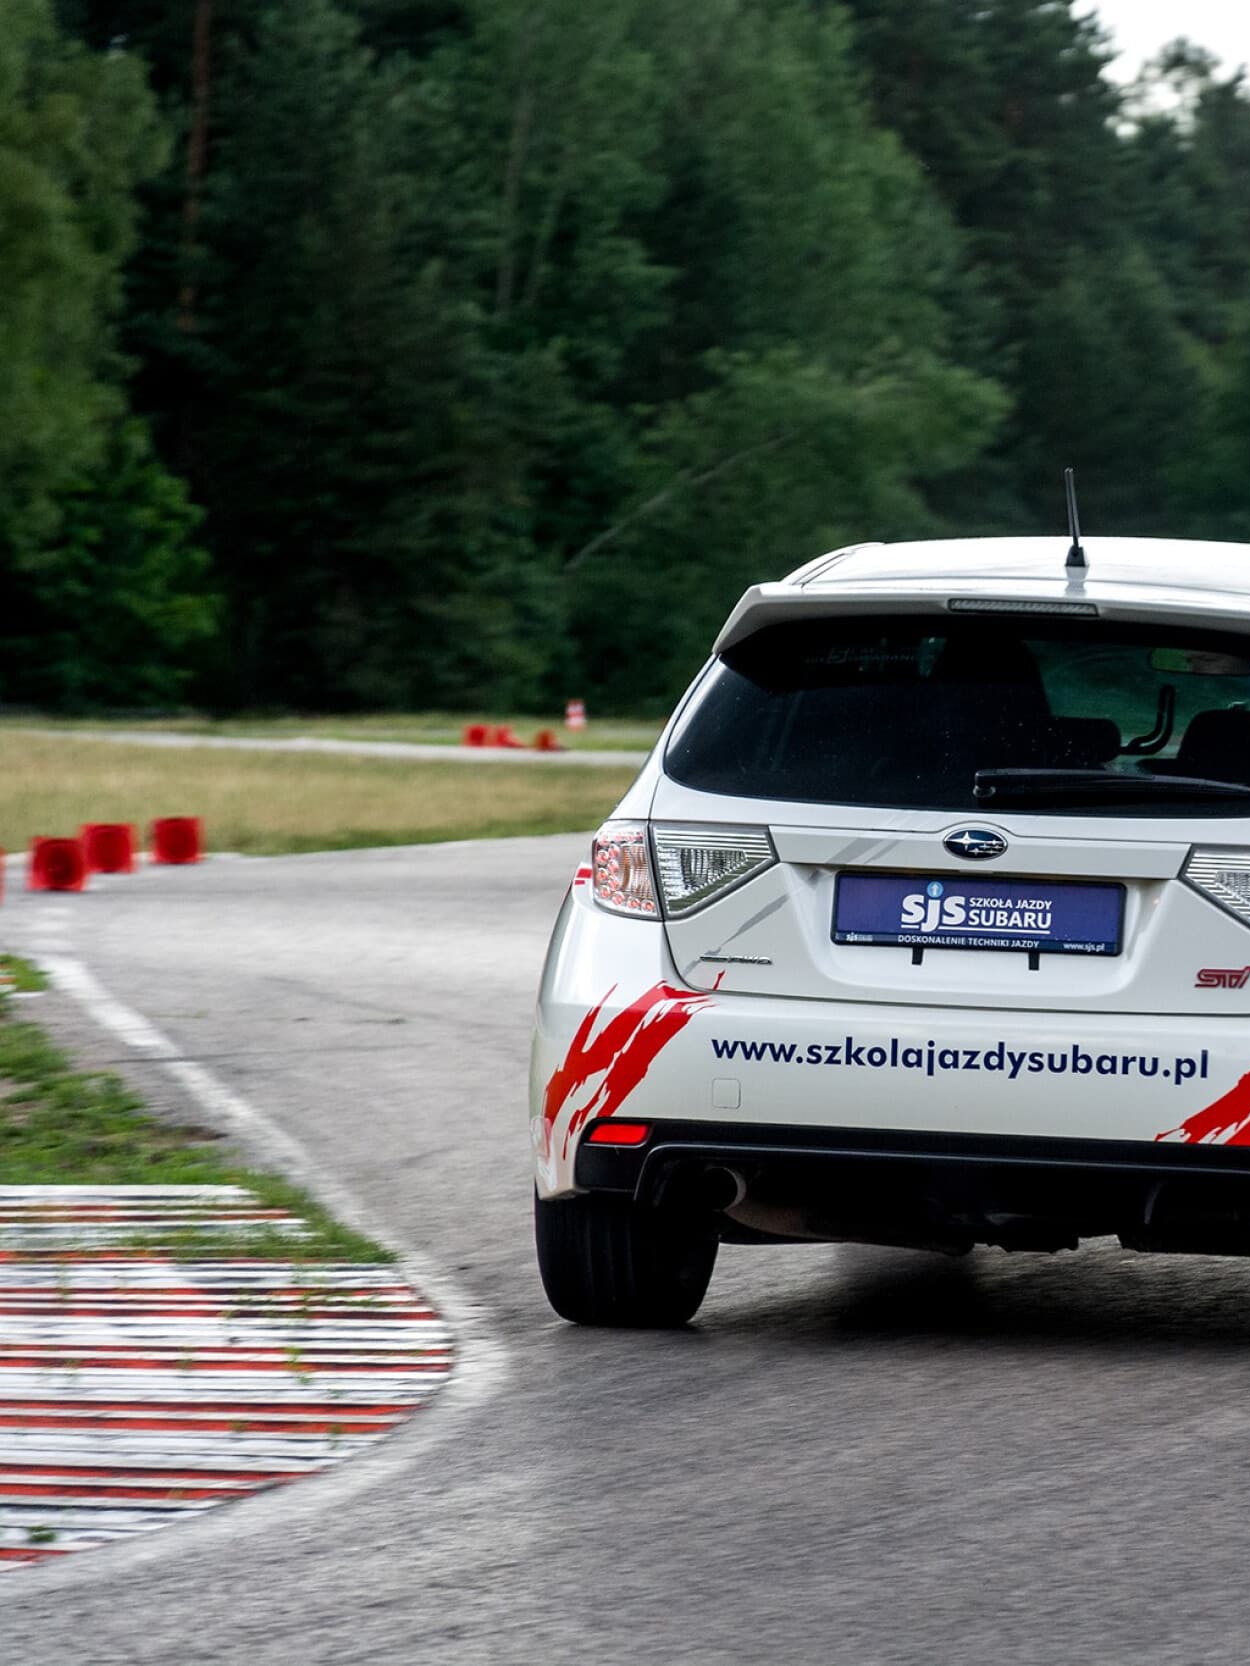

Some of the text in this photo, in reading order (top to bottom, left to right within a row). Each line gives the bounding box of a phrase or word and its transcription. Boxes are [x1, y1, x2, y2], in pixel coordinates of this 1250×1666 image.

[969, 897, 1052, 910] SZKOŁA JAZDY
[968, 910, 1052, 928] SUBARU
[897, 935, 1040, 948] DOSKONALENIE TECHNIKI JAZDY
[711, 1037, 1209, 1085] www.szkolajazdysubaru.pl
